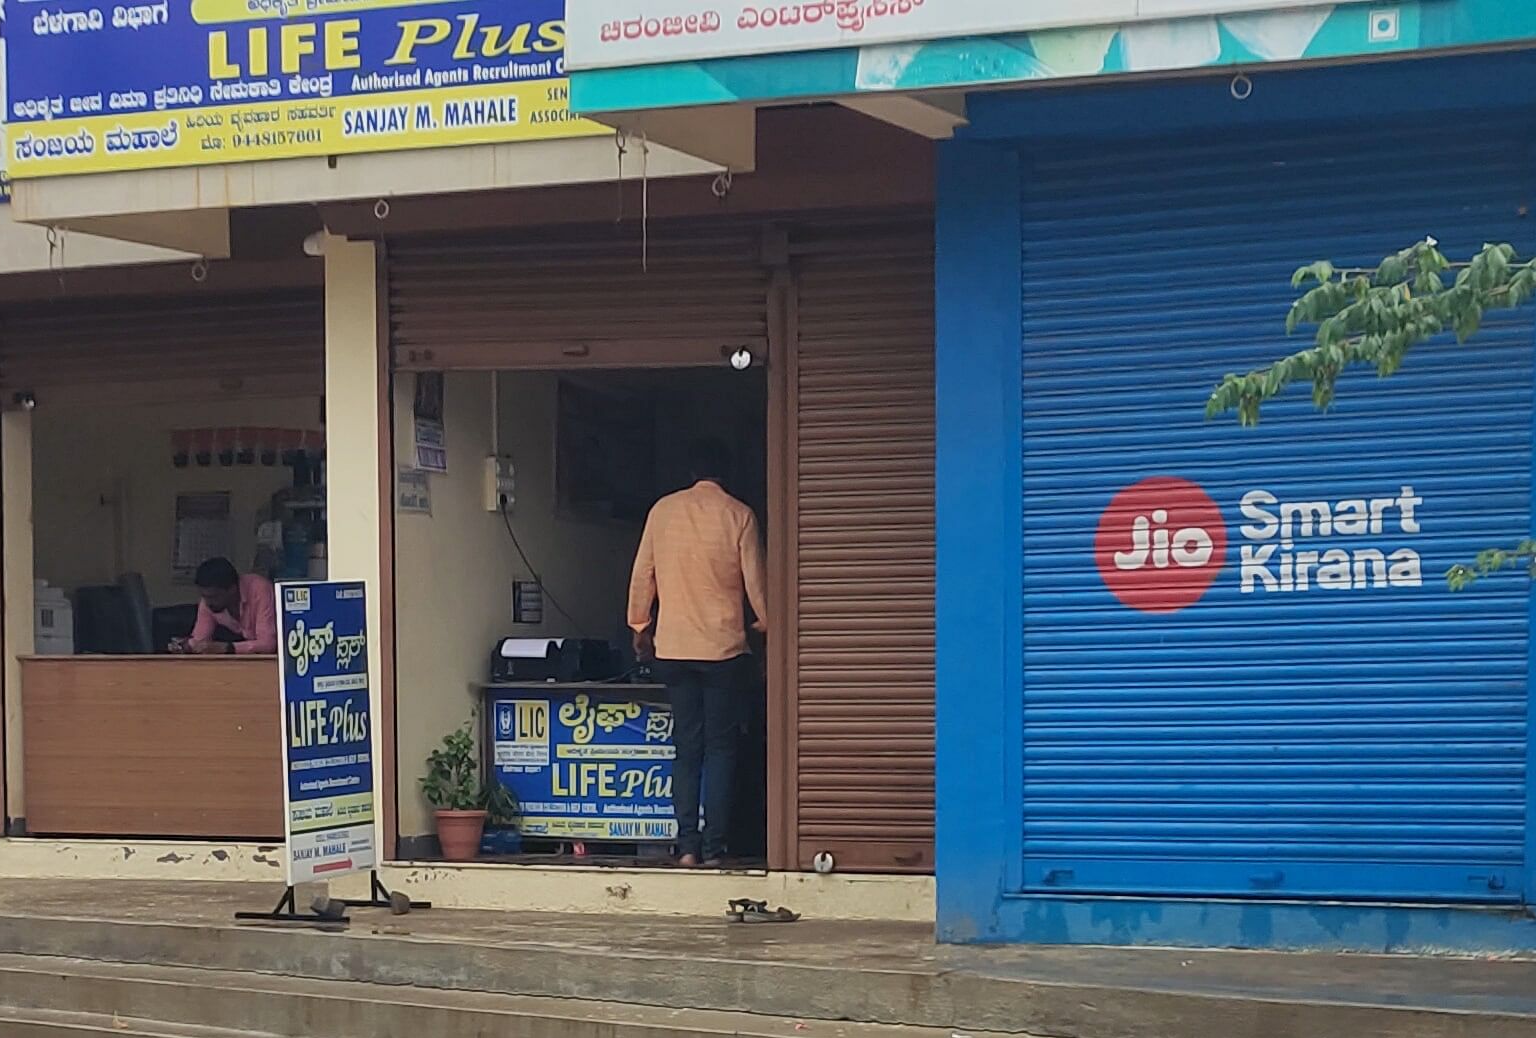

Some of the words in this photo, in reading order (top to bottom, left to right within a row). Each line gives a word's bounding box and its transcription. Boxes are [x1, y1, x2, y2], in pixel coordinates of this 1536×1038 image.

[33, 9, 104, 35] ಬೆಳಗಾವಿ
[600, 9, 721, 42] ಚಿರಂಜೀವಿ
[208, 18, 361, 80] LIFE
[384, 13, 565, 65] Plus
[351, 67, 420, 91] Authorised
[425, 69, 469, 87] Agents
[473, 59, 551, 81] Recruitment
[344, 106, 408, 135] SANJAY
[415, 105, 437, 129] M.
[445, 98, 517, 126] MAHALE
[16, 130, 95, 160] ಸಂಜಯ
[105, 120, 178, 152] ಮಹಾಲೆ
[1239, 486, 1422, 541] Smart
[1113, 509, 1213, 570] Jio
[1239, 538, 1422, 592] Kirana
[288, 619, 334, 677] ಲೈಫ್
[336, 630, 366, 671] ಪ್ಲಸ್
[290, 699, 328, 748] LIFE
[330, 698, 367, 744] Plus
[519, 706, 545, 738] LIC
[559, 694, 641, 744] ಲೈಫ್
[552, 763, 617, 797] LIFE
[609, 822, 633, 836] SANJAY
[644, 822, 672, 838] MAHALE
